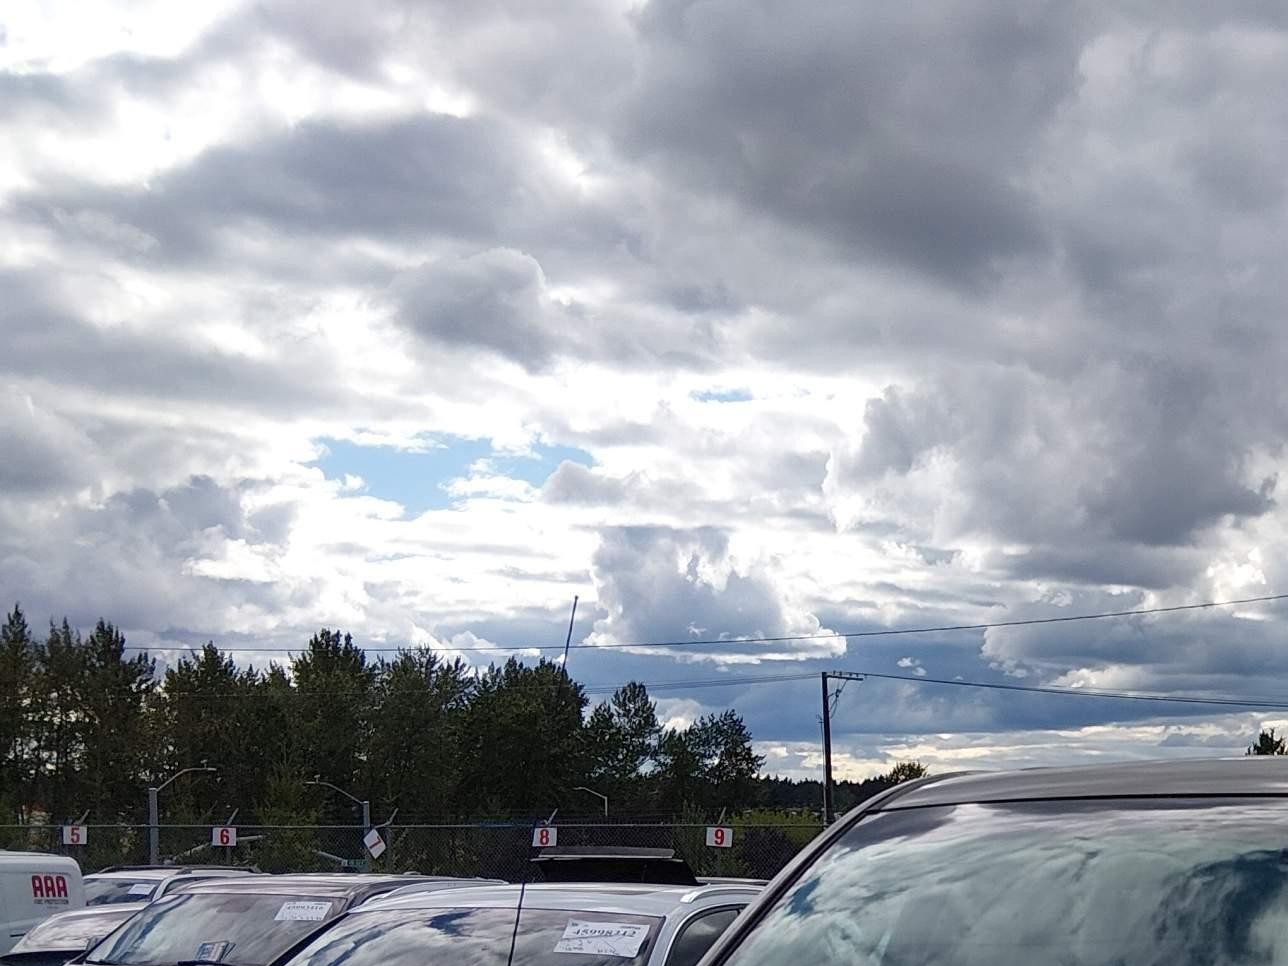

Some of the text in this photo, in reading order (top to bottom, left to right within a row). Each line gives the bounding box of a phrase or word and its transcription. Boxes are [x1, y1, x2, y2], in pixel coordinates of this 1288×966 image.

[71, 827, 80, 844] 5
[220, 828, 230, 845] 6
[540, 829, 549, 846] 8
[714, 828, 725, 846] 9
[31, 875, 68, 898] AAA
